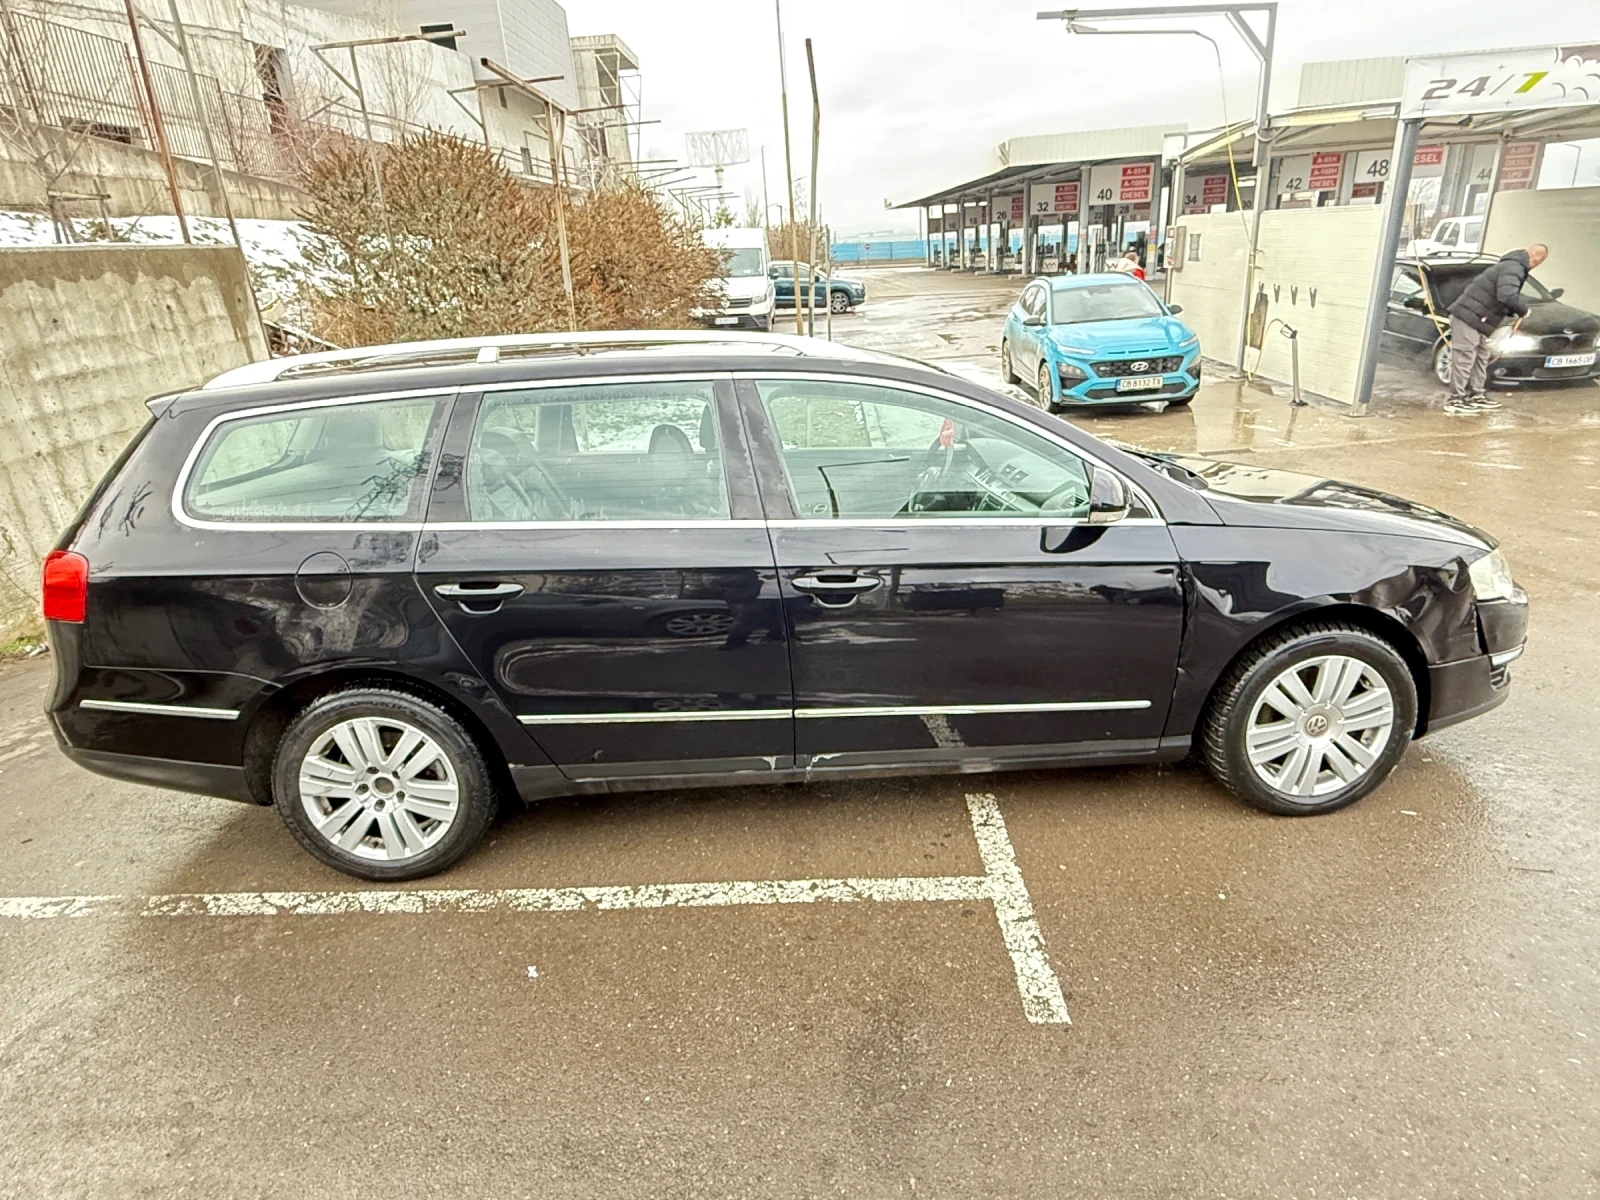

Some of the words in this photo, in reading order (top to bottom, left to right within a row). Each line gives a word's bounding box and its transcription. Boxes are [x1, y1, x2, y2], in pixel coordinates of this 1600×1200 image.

[1420, 71, 1549, 100] 24/7
[1414, 153, 1439, 164] ESEL
[1367, 159, 1389, 177] 48
[1286, 177, 1302, 190] 42
[1310, 179, 1336, 188] DIESEL
[1096, 188, 1113, 201] 40
[1121, 191, 1146, 200] DIESEL
[1185, 195, 1197, 205] 34
[1037, 202, 1049, 212] 32
[997, 211, 1007, 220] 26
[1122, 380, 1131, 388] CB
